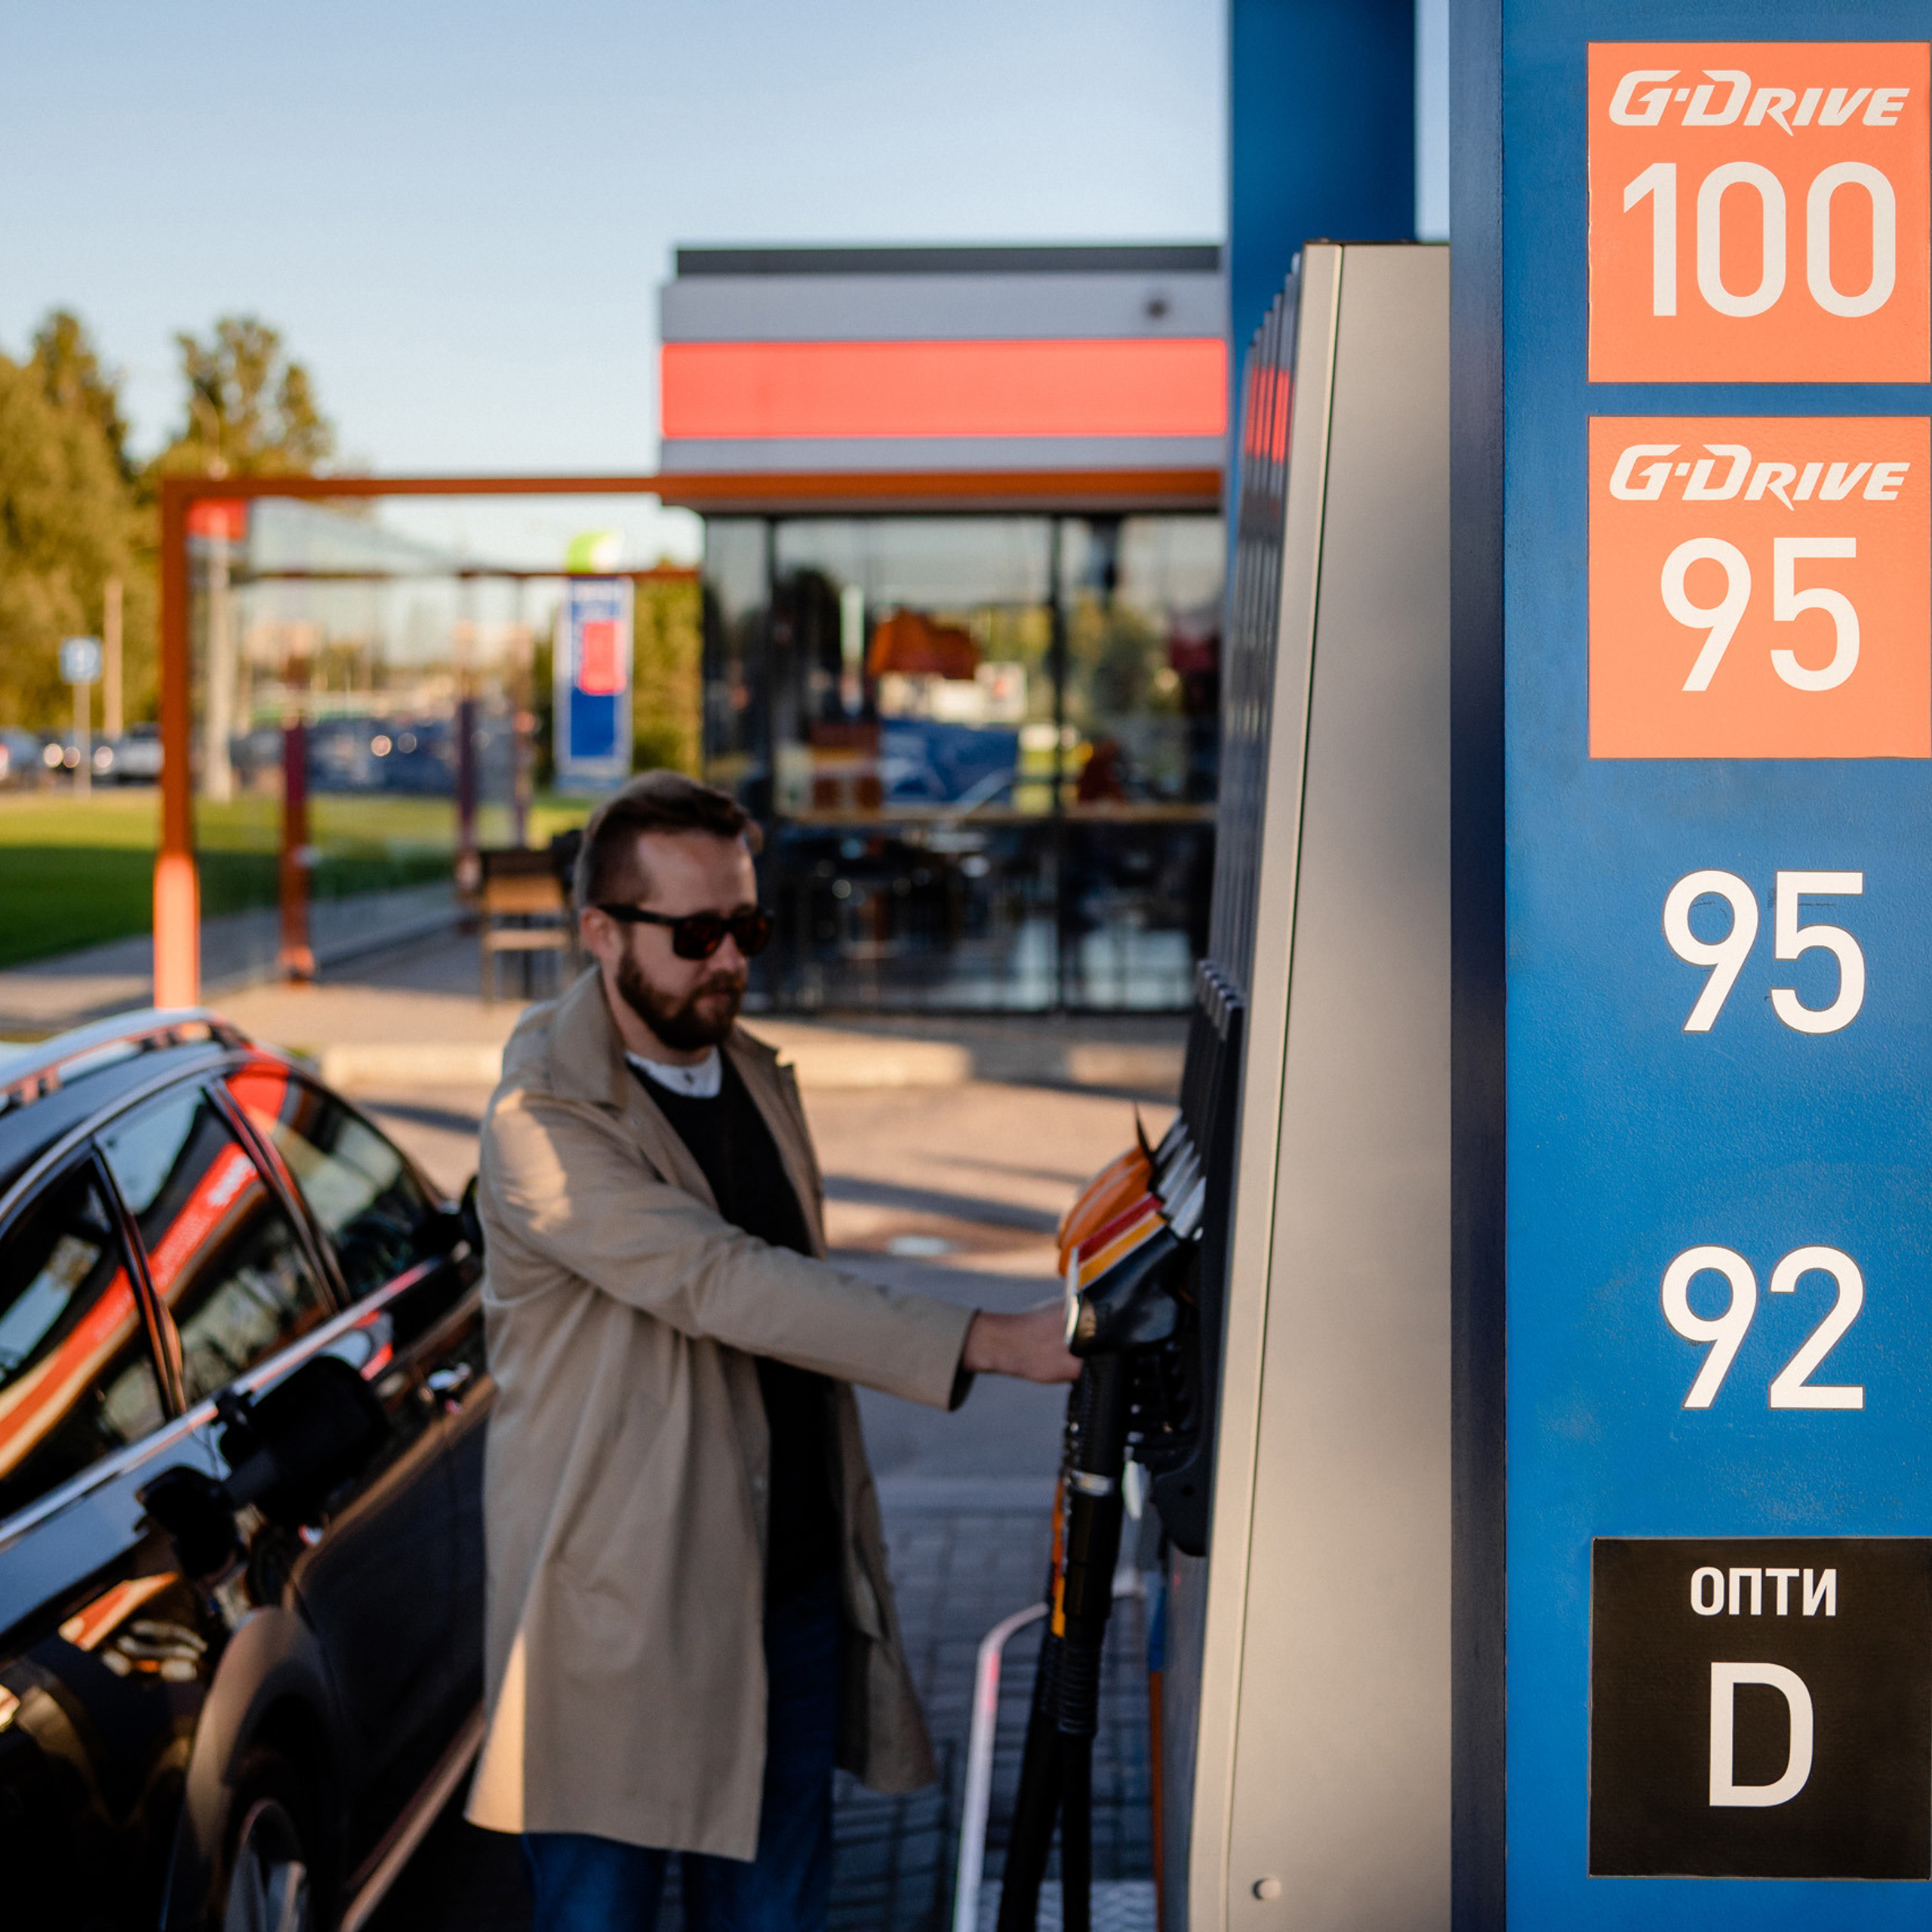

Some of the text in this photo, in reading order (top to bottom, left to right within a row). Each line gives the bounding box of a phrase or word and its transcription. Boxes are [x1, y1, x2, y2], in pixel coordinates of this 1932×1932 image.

[1624, 162, 1896, 317] 100
[1660, 537, 1860, 691] 95
[1663, 869, 1866, 1034] 95
[1662, 1245, 1864, 1409] 92
[1690, 1566, 1836, 1616] ОПТИ
[1709, 1662, 1814, 1807] D
